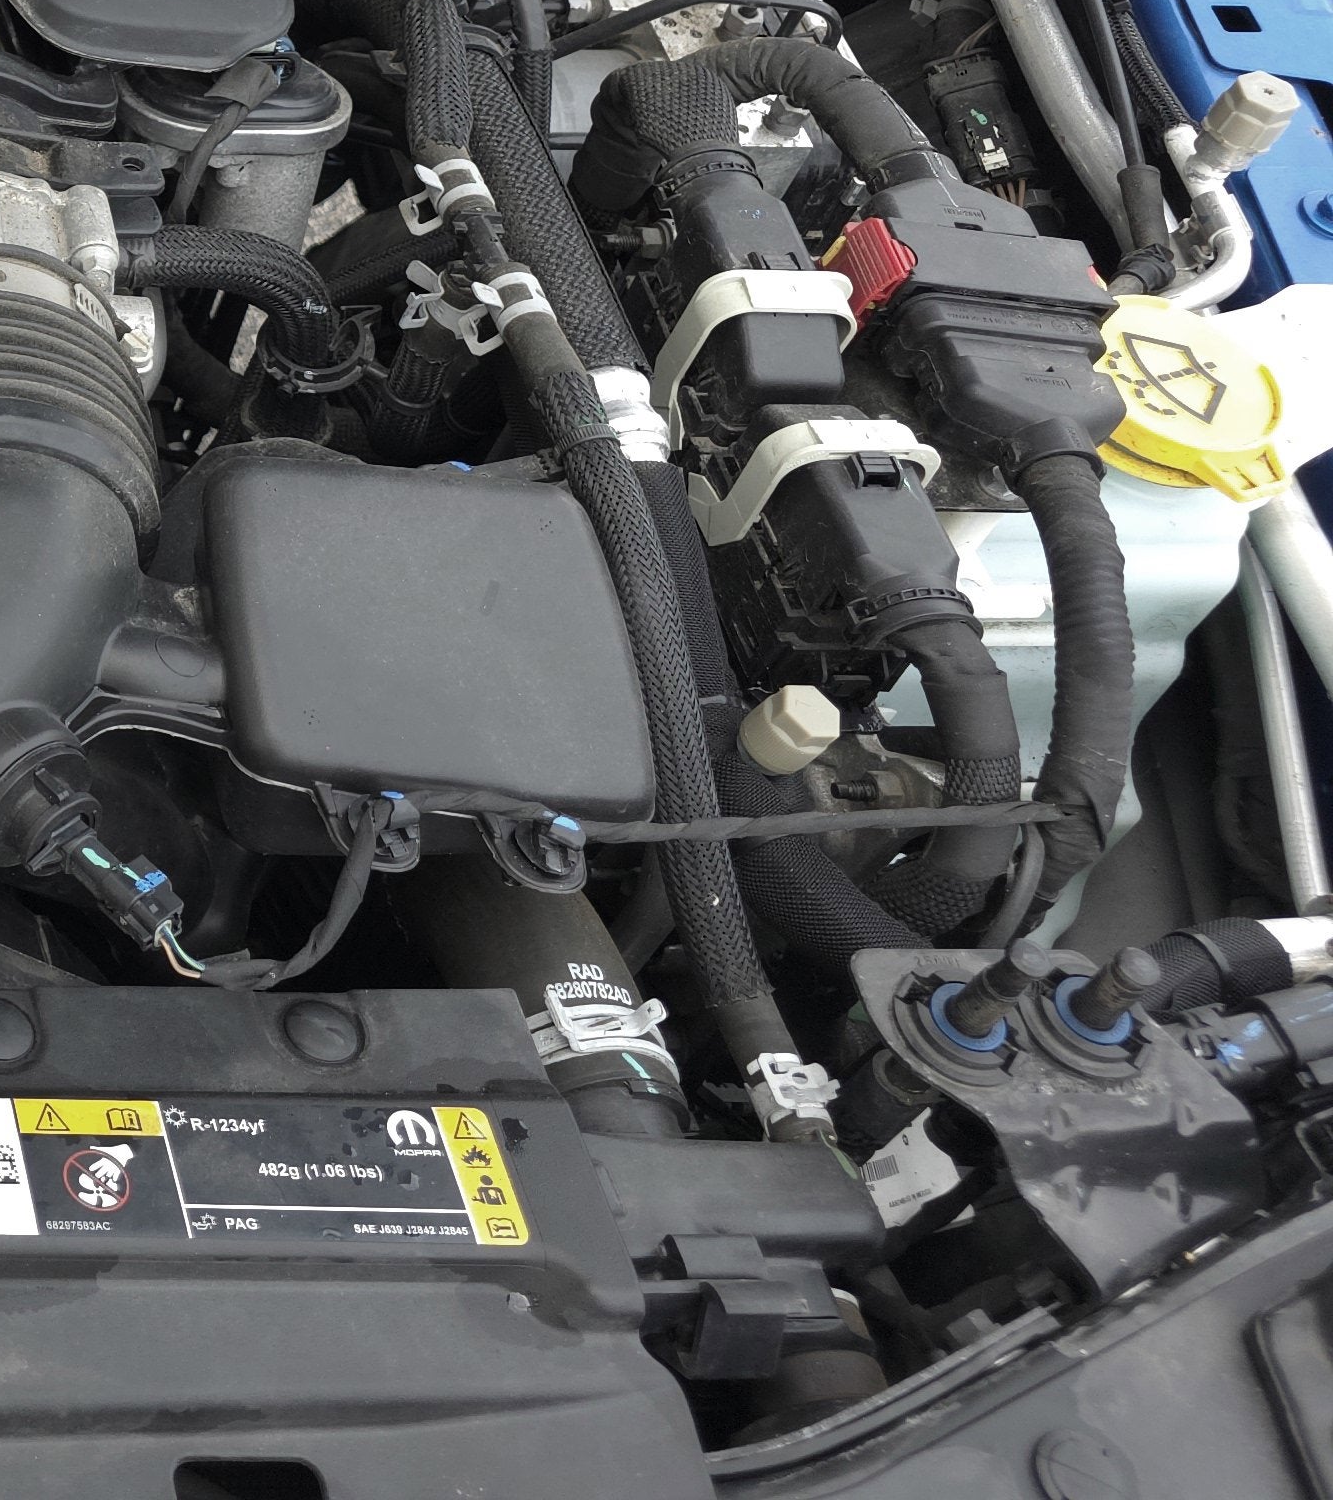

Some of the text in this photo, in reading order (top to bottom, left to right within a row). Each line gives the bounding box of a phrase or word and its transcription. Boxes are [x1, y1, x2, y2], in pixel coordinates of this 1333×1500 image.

[567, 962, 604, 981] RAD
[189, 1117, 266, 1135] R-1234yf
[394, 1148, 442, 1157] MOPAR
[258, 1162, 384, 1182] 482g (1.06 lbs)
[225, 1217, 260, 1231] PAG
[353, 1223, 377, 1234] SAE
